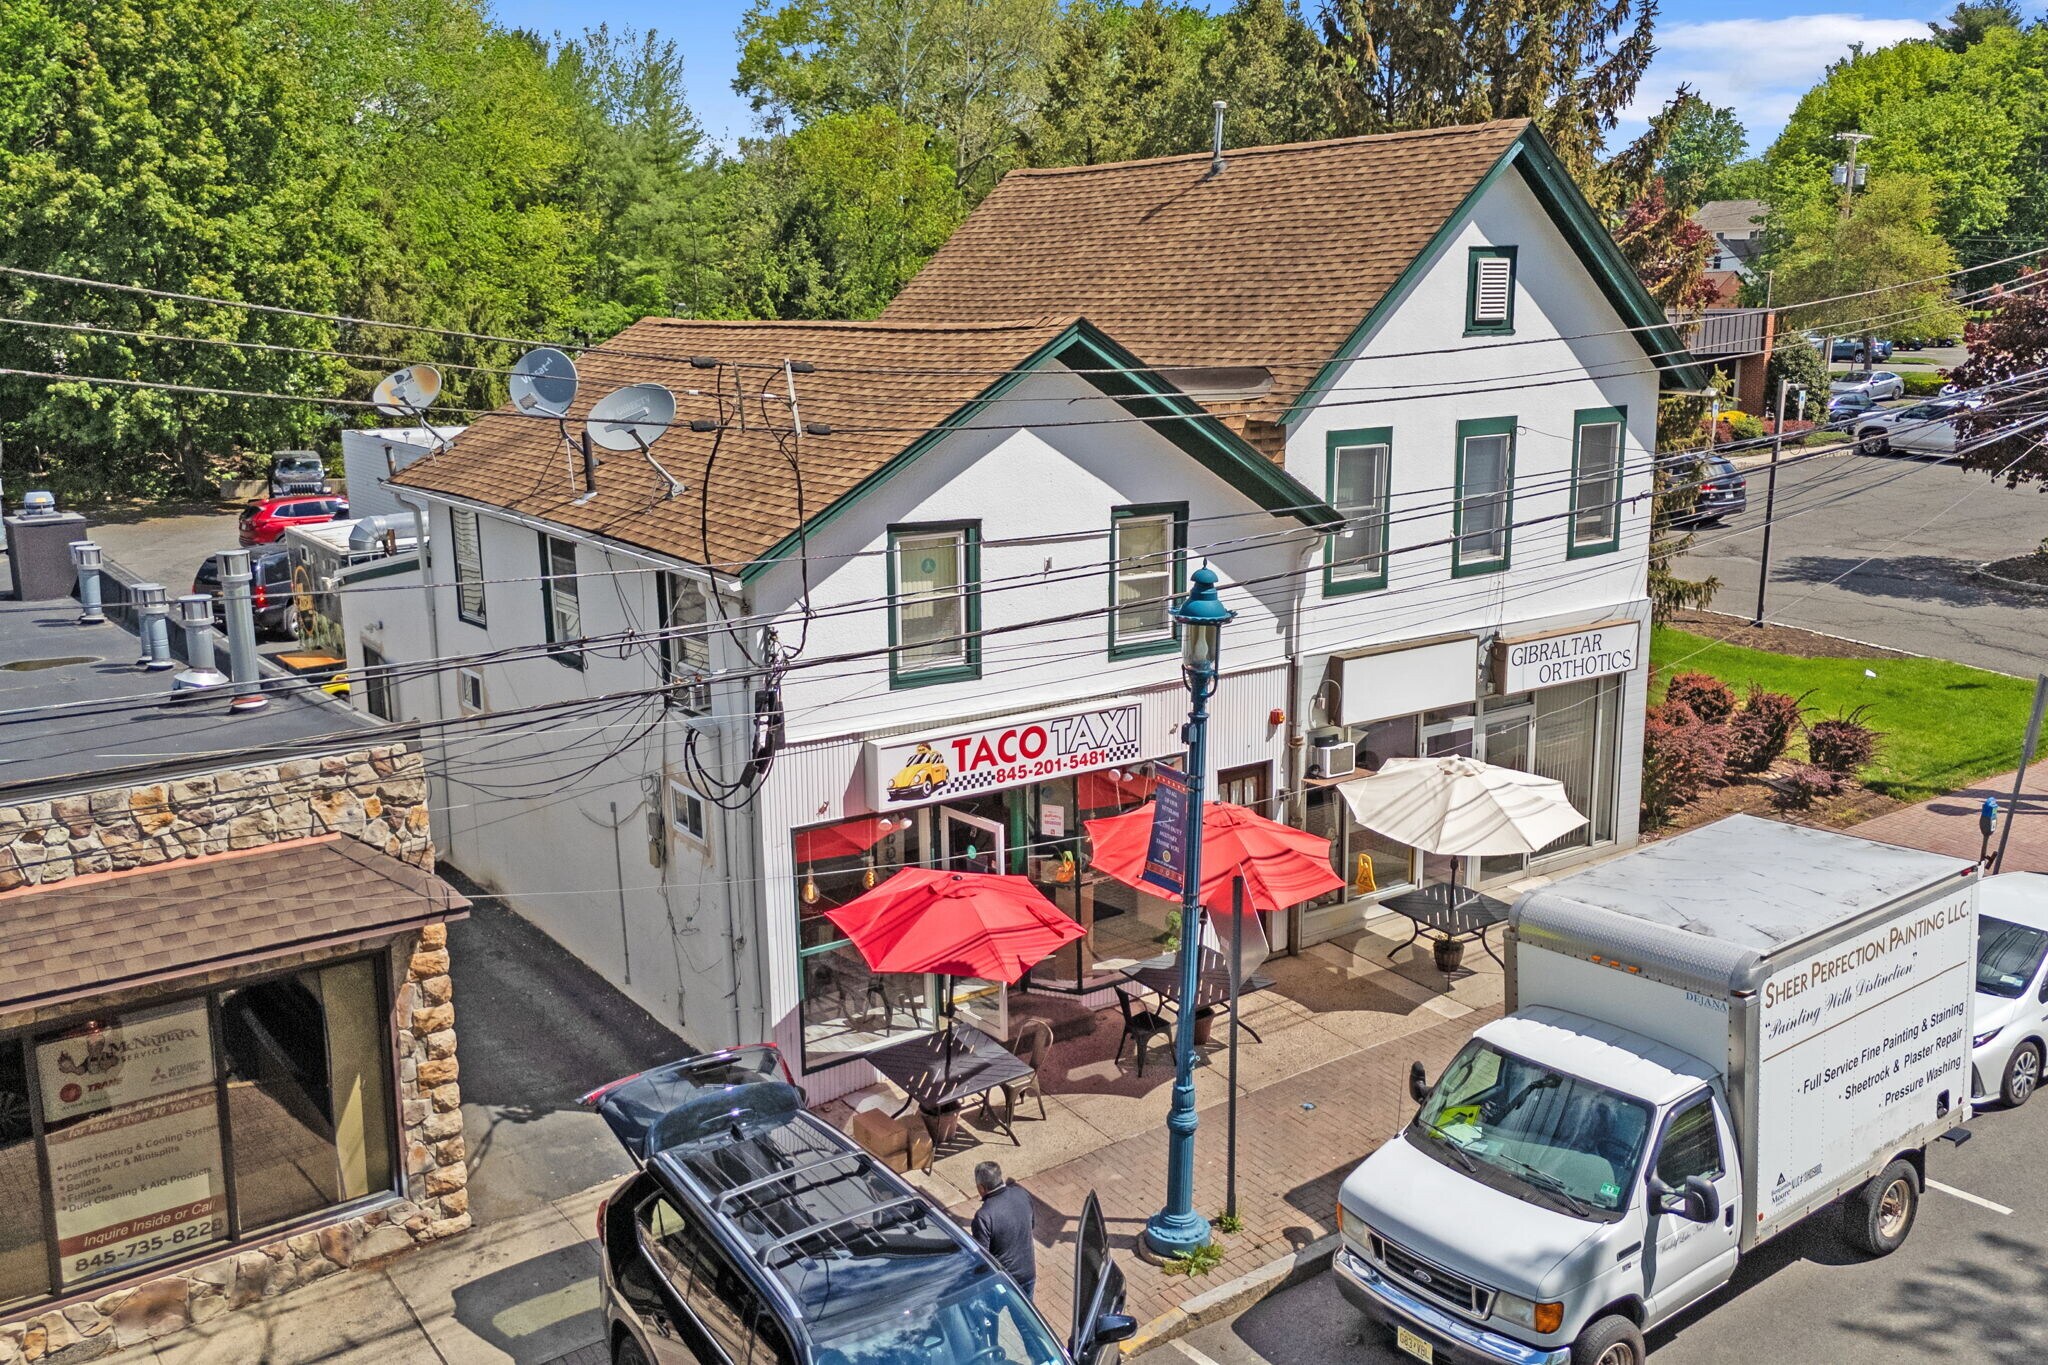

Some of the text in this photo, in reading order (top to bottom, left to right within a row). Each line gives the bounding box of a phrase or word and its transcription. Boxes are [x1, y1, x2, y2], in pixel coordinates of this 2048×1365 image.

[1511, 634, 1602, 667] GIBRALTAR
[1539, 649, 1631, 683] ORTHOTICS
[951, 706, 1137, 772] TACO TAXI
[1765, 901, 1969, 1008] SHEER PERFECTION PAINTING LLC.
[1686, 991, 1727, 1011] DEJANA
[1827, 986, 1852, 1010] With
[121, 1045, 171, 1062] SERVICES
[1803, 1002, 1964, 1094] Full Service Fine Painting & Staining
[1845, 1027, 1963, 1100] Sheetrock & Plaster Repair
[1885, 1056, 1961, 1107] Pressure Washing
[89, 1118, 119, 1132] More
[122, 1111, 149, 1125] than
[152, 1106, 166, 1117] 30
[64, 1156, 93, 1170] Home
[95, 1146, 133, 1160] Heating
[135, 1142, 143, 1150] &
[145, 1132, 183, 1148] Cooling
[65, 1164, 101, 1182] Central
[124, 1156, 131, 1166] &
[66, 1176, 101, 1192] Boilers
[67, 1183, 113, 1202] Furnaces
[69, 1200, 93, 1213] Duct
[94, 1187, 138, 1204] Cleaning
[140, 1182, 148, 1191] &
[170, 1165, 212, 1183] Products
[84, 1199, 216, 1247] Inquire Inside or Call
[75, 1217, 223, 1272] 845-735-8228
